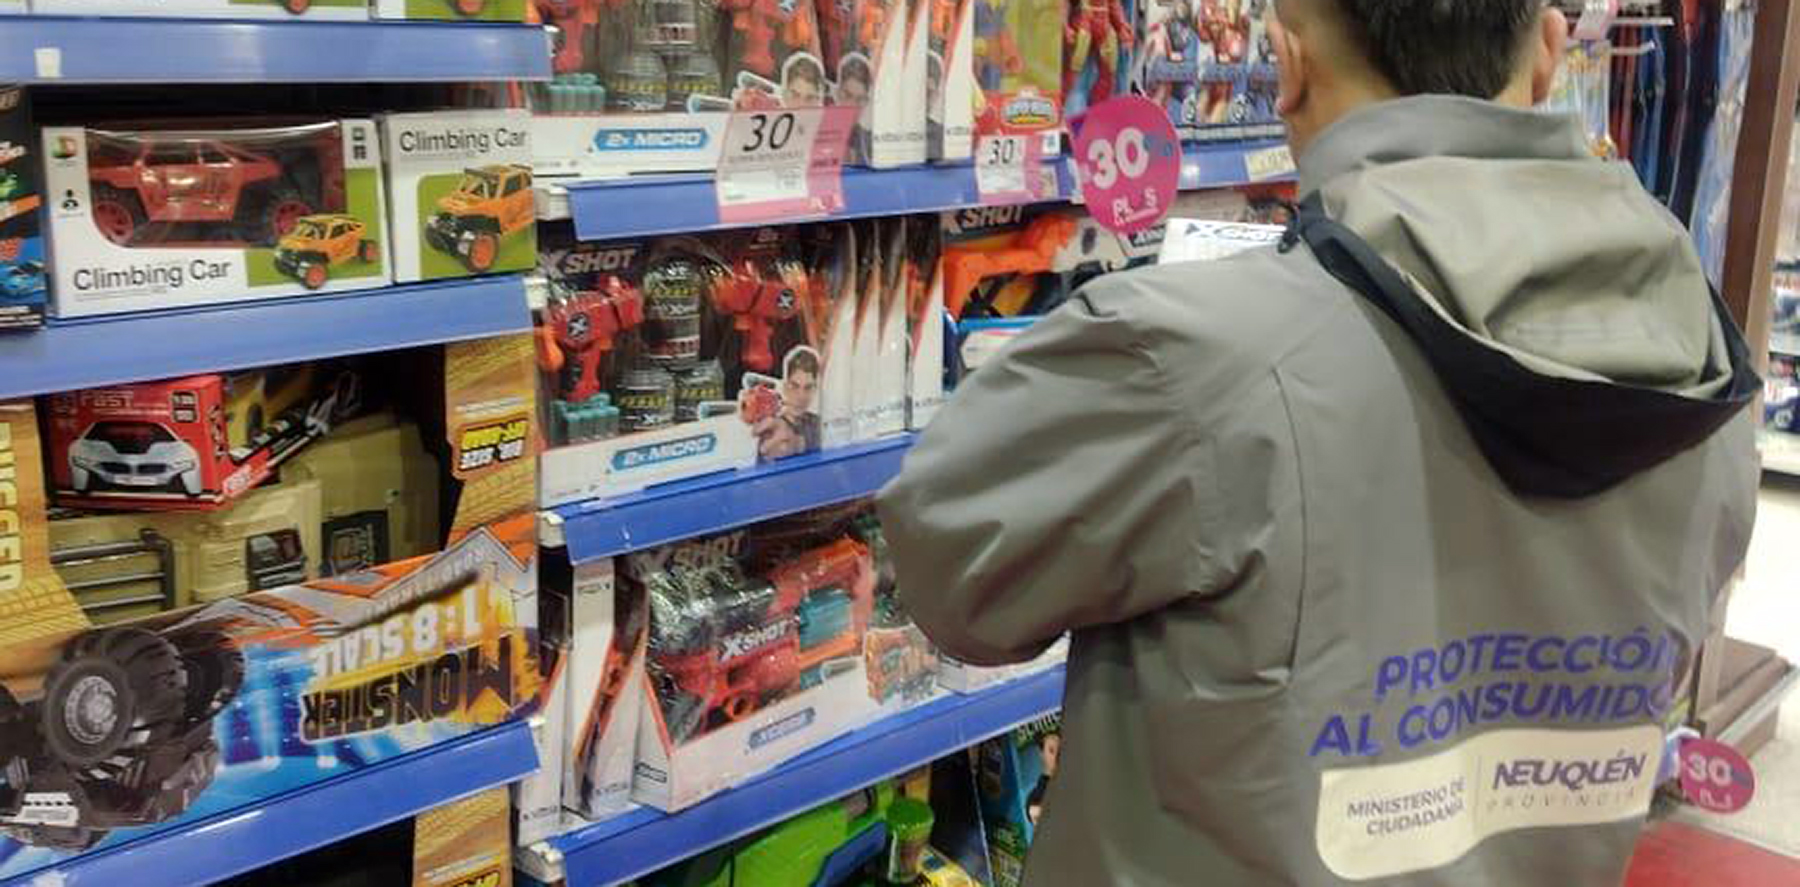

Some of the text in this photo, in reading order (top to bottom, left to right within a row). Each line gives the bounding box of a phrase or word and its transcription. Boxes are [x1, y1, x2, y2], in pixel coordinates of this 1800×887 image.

[399, 127, 526, 153] Climbing Car
[633, 131, 701, 146] MICRO
[743, 112, 796, 152] 30
[988, 138, 1014, 165] 30
[73, 258, 231, 292] Climbing Car
[651, 437, 711, 461] MICRO
[302, 635, 513, 742] MONSTER
[1310, 714, 1382, 757] AL
[1687, 752, 1732, 787] 30
[1347, 783, 1447, 819] MINISTERIO
